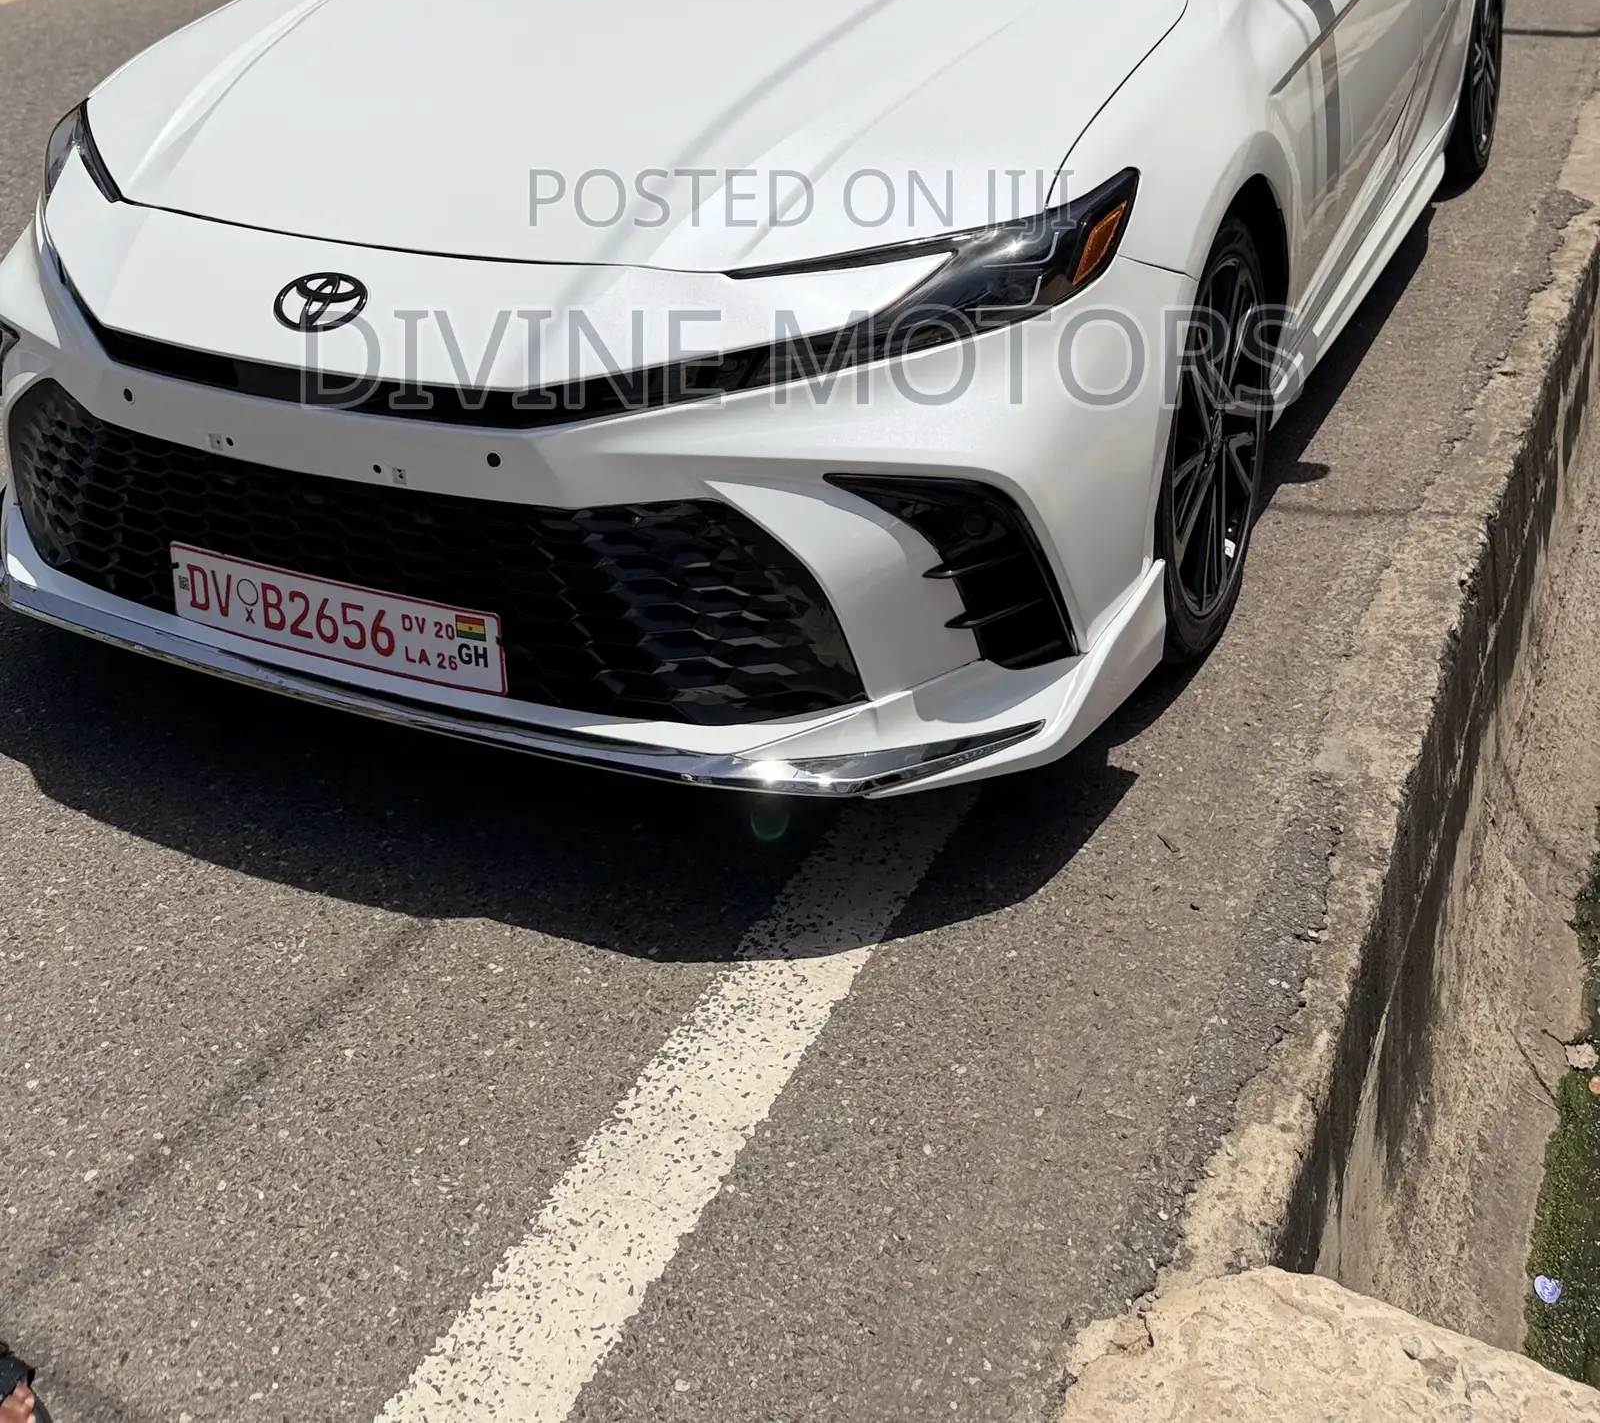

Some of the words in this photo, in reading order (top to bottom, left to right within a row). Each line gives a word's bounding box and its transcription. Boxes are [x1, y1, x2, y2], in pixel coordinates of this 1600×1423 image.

[261, 582, 396, 657] B2656
[401, 613, 426, 635] DV
[433, 621, 455, 641] 20
[404, 645, 431, 666] LA
[436, 652, 458, 671] 26
[457, 642, 489, 669] GH
